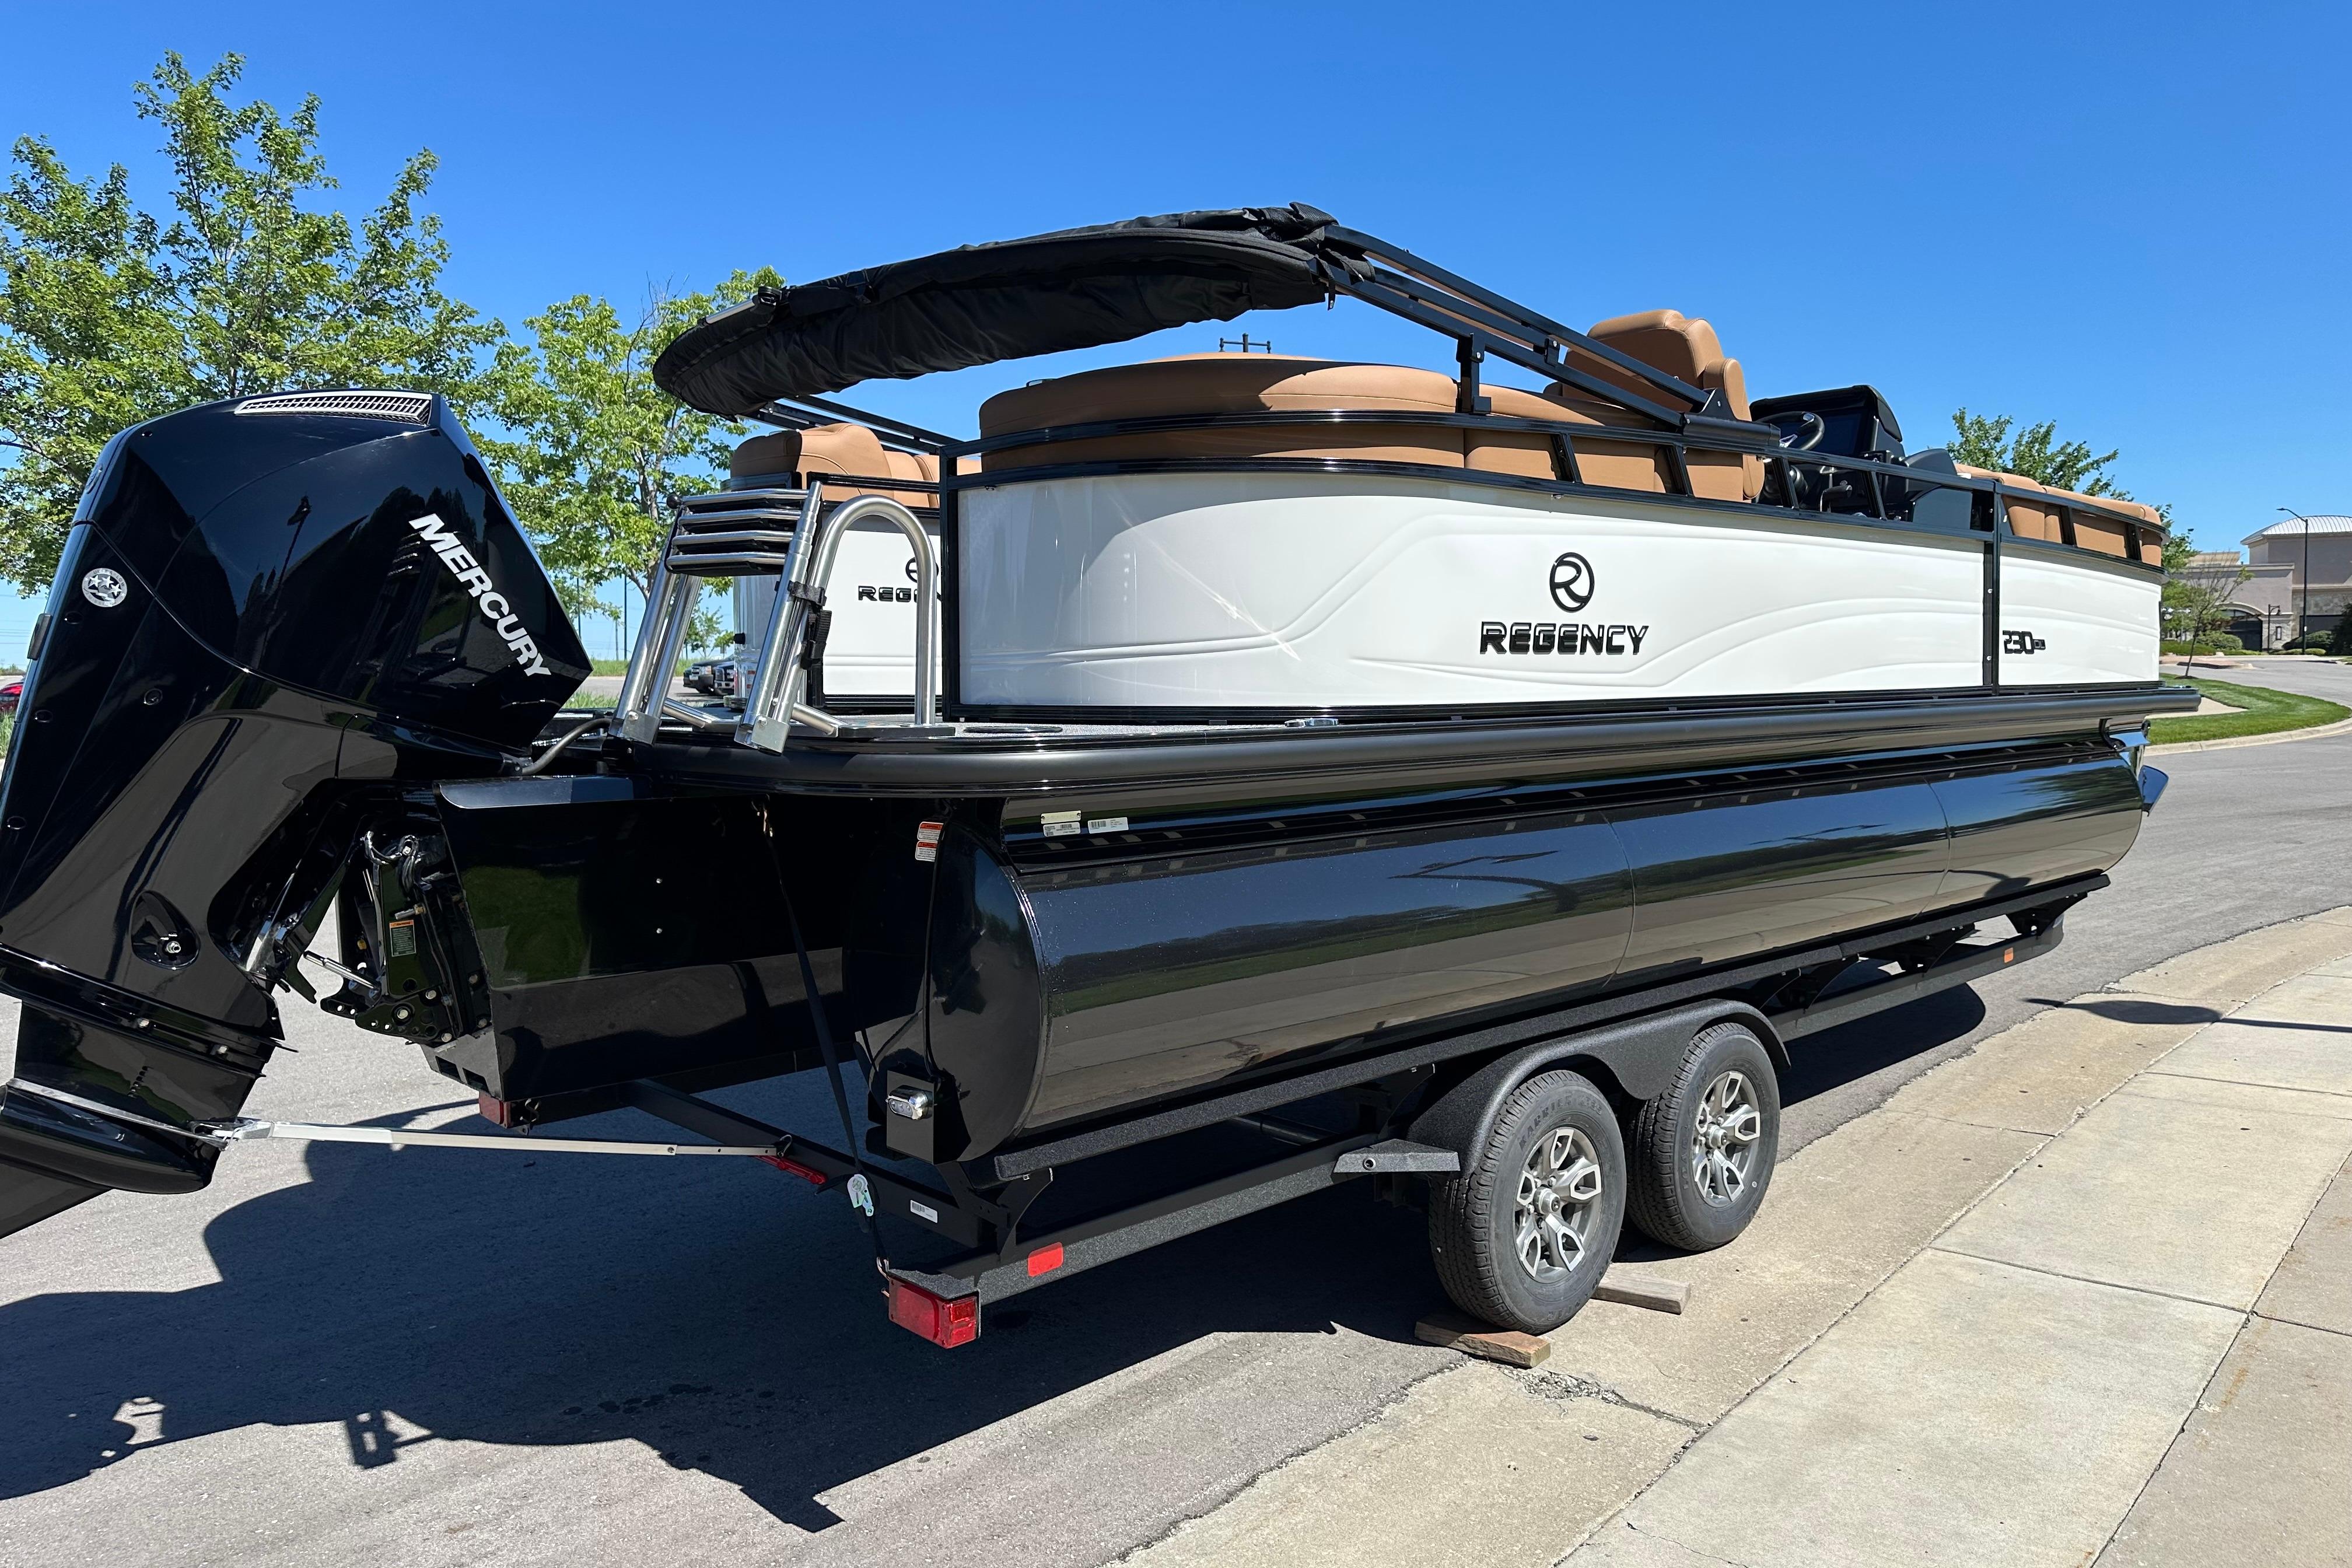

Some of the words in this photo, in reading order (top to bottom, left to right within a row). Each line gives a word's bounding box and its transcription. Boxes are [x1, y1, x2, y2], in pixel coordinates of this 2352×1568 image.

[408, 513, 551, 676] MERCURY
[1480, 621, 1649, 655] REGENCY
[2003, 630, 2034, 654] 230
